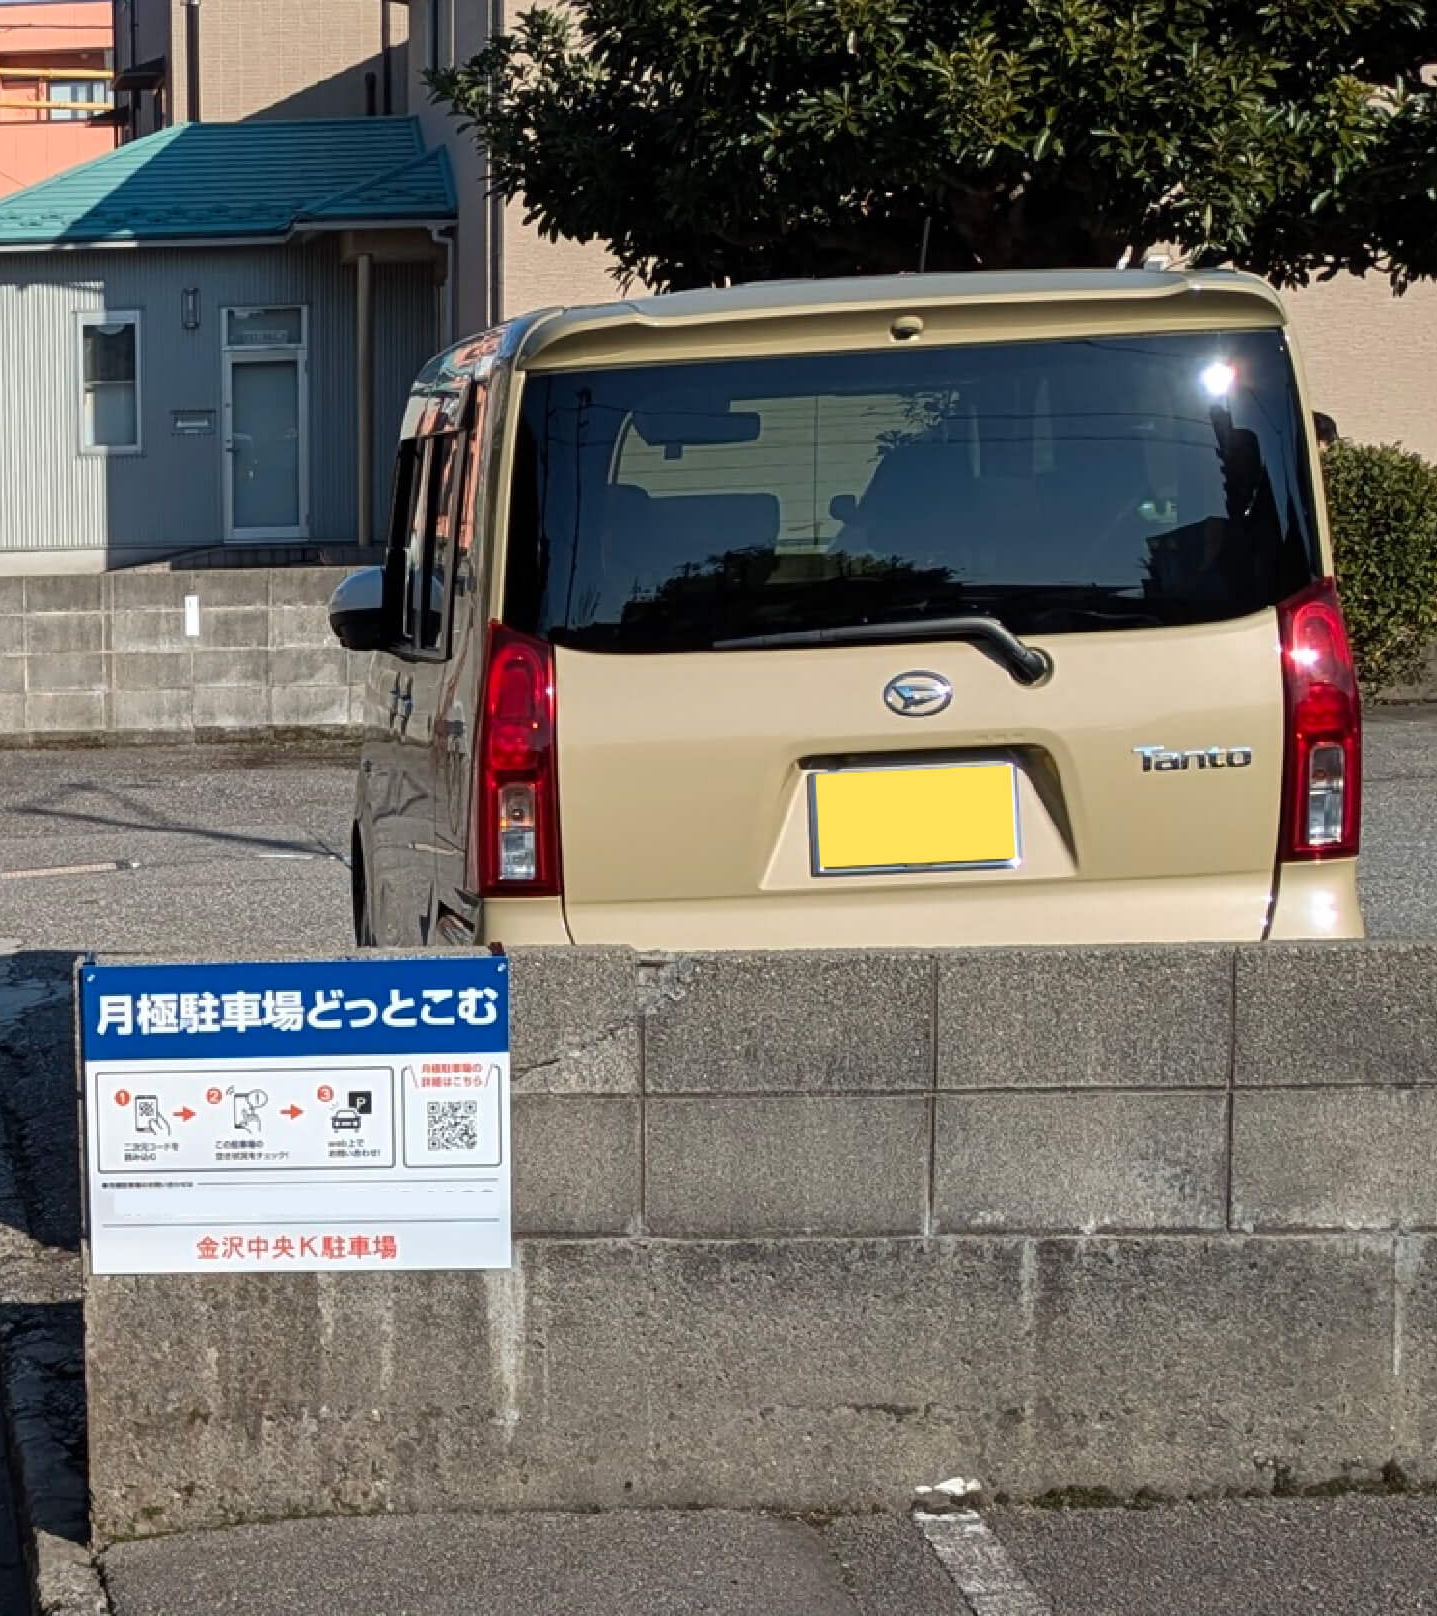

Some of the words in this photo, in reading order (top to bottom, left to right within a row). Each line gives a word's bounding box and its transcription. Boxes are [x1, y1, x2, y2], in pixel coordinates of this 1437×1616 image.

[1132, 744, 1253, 773] Tanto
[97, 987, 498, 1036] 月極駐車場どっとこむ
[421, 1076, 483, 1088] 詳細はこちら
[196, 1235, 398, 1260] 金沢中央K駐車場
